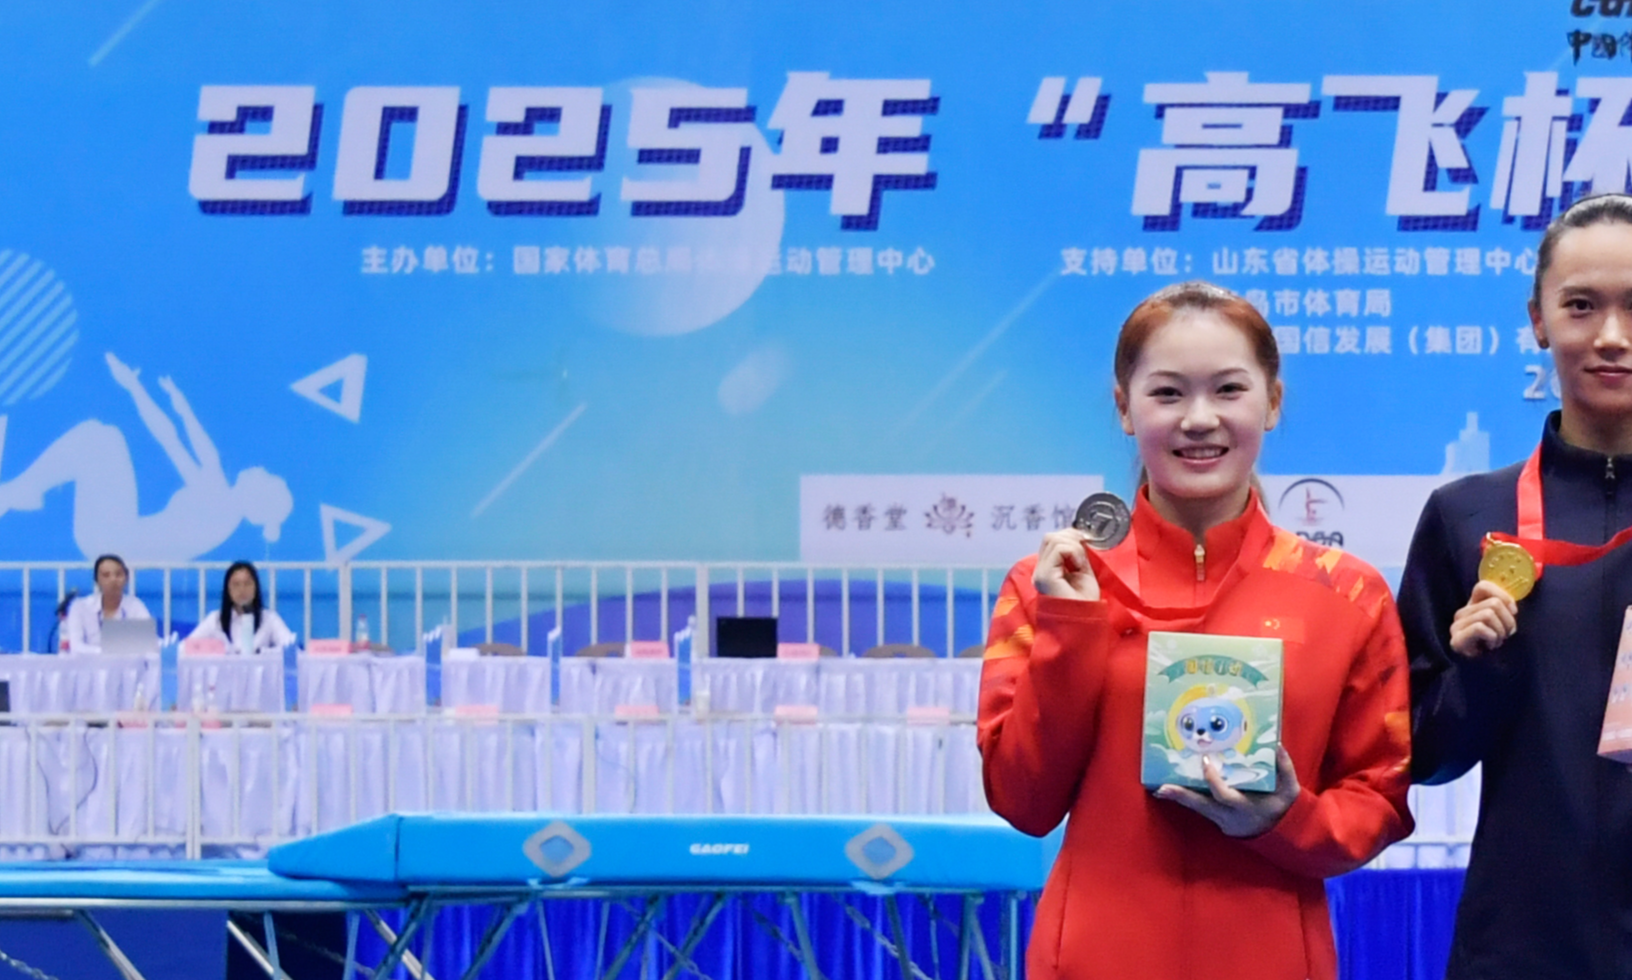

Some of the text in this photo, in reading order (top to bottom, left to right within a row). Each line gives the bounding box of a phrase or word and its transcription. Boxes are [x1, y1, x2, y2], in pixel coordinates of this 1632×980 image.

[188, 71, 940, 231] 2025年
[1232, 288, 1392, 318] 岛市体育局
[689, 843, 750, 855] GAOFEI
